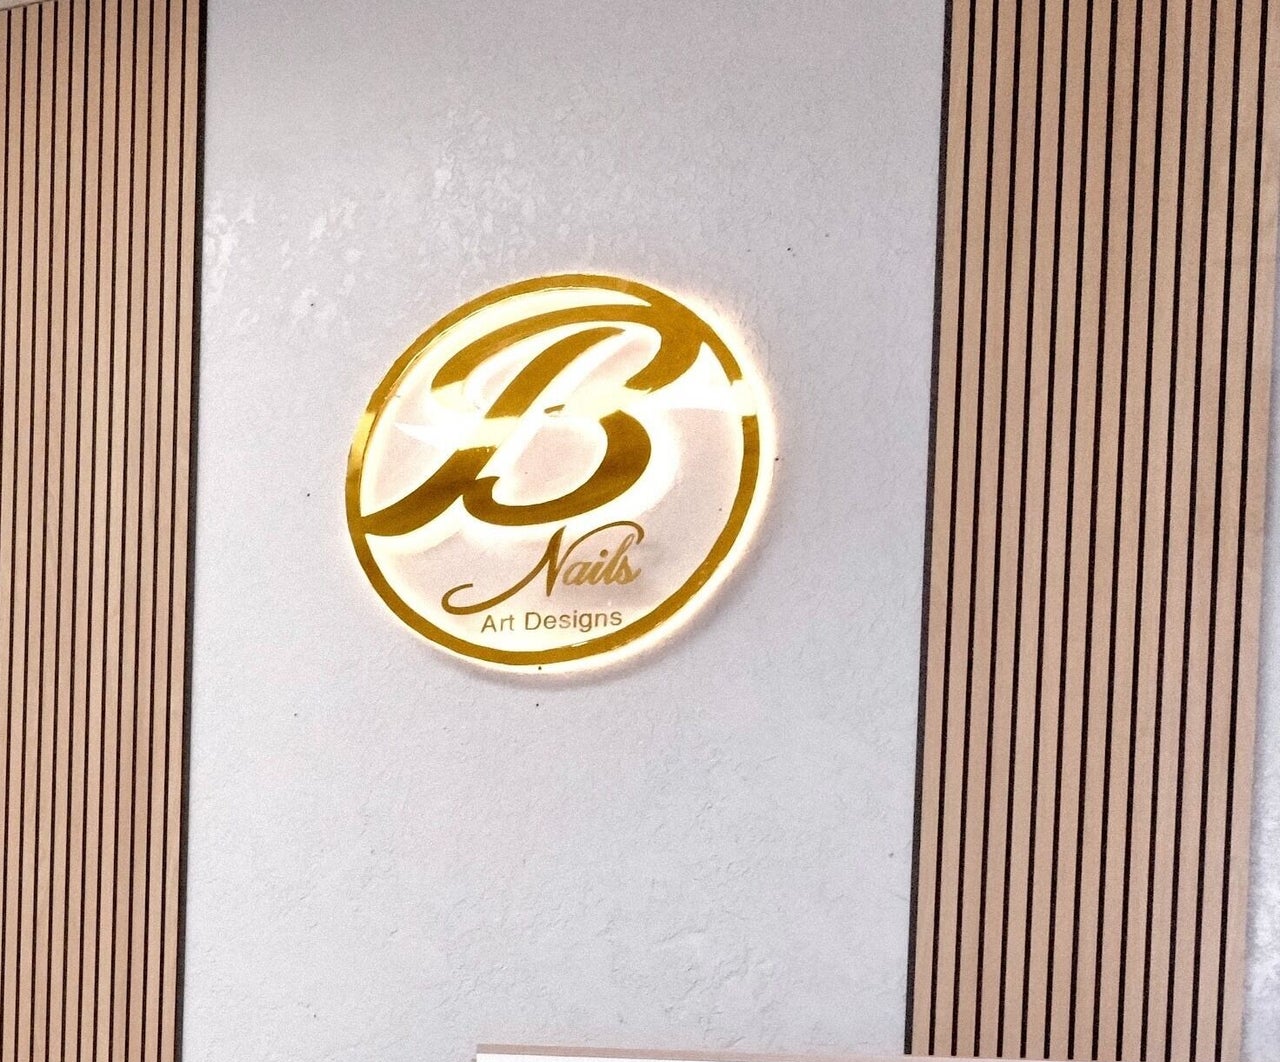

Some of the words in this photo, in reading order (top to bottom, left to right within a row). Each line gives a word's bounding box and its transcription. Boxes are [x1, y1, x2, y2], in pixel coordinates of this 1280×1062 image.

[361, 303, 704, 535] B
[441, 520, 645, 615] Nails
[481, 614, 515, 634] Art
[524, 609, 623, 633] Designs
